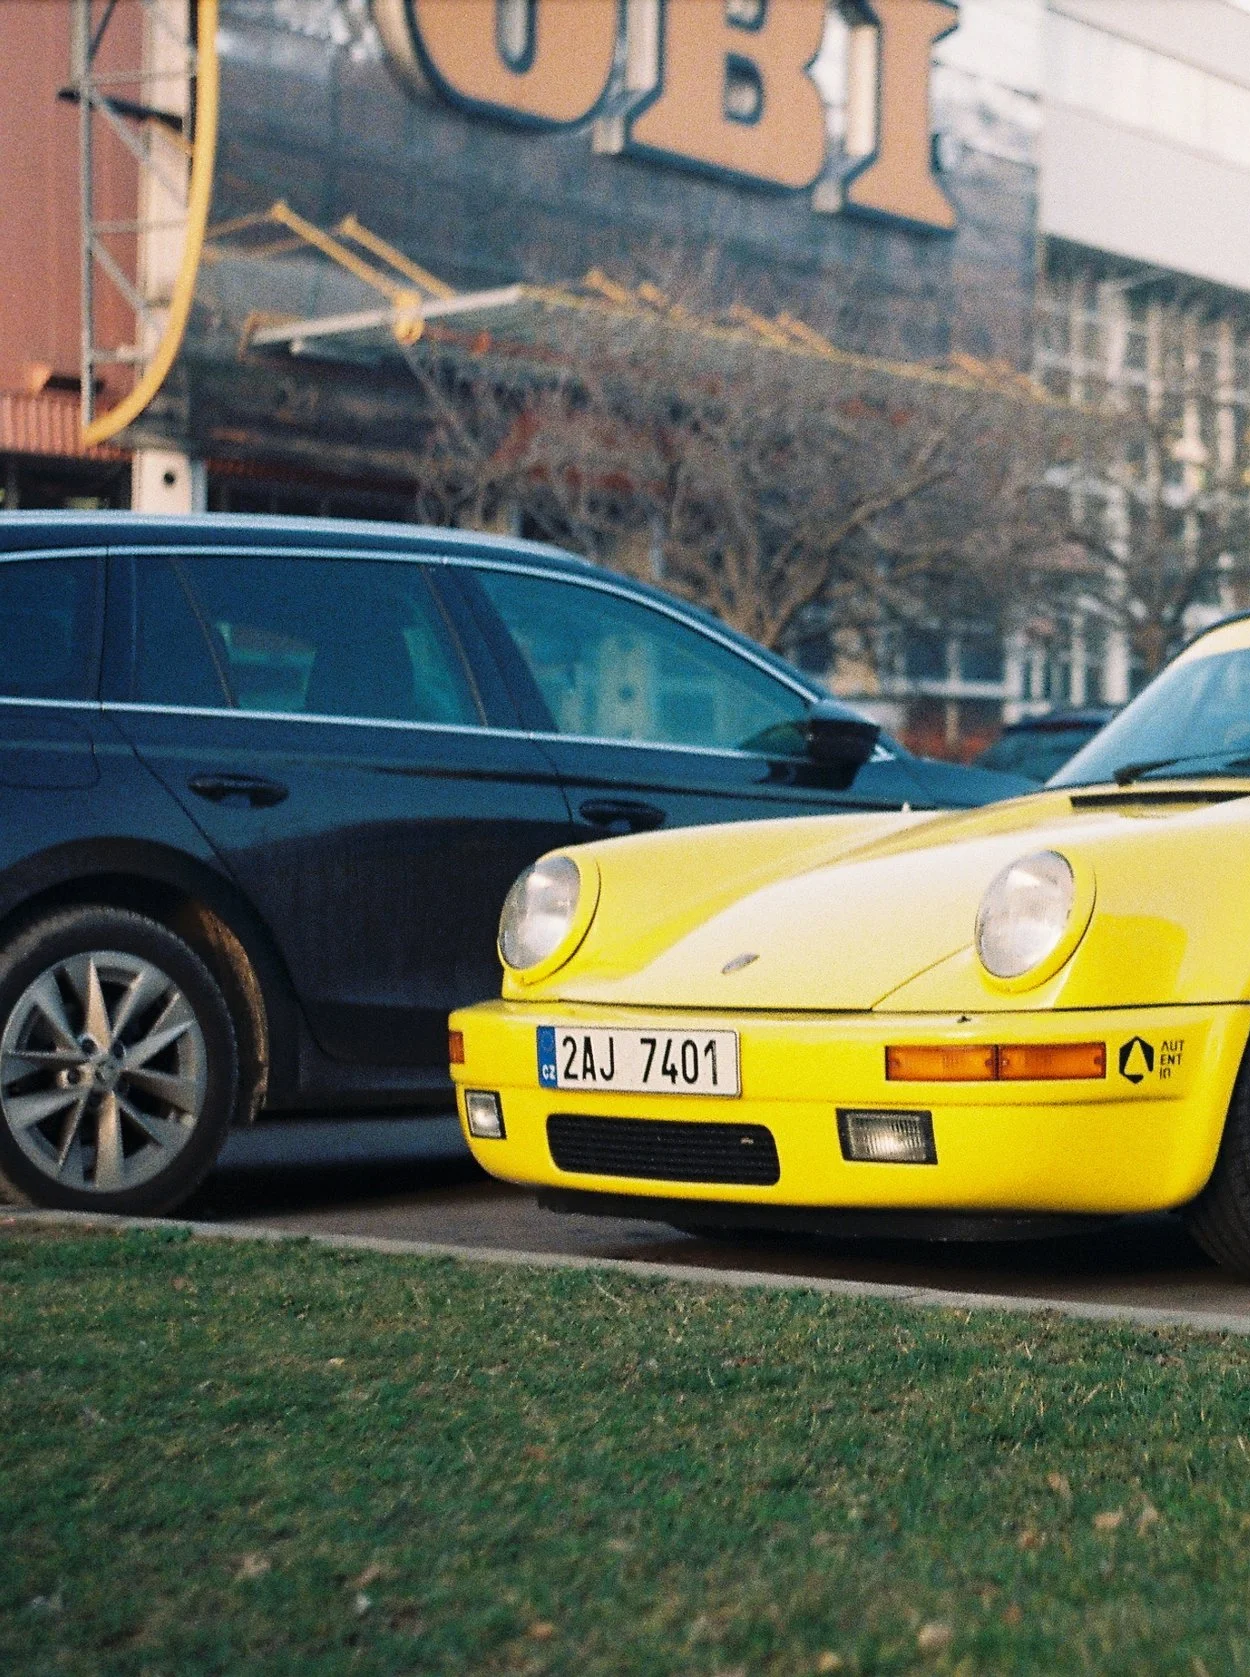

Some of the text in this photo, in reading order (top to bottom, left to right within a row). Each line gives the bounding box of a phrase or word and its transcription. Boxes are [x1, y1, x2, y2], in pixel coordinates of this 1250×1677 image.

[1160, 1040, 1184, 1051] AUT
[562, 1036, 718, 1085] 2AJ 7401
[1160, 1053, 1182, 1066] ENT
[542, 1064, 556, 1080] CZ
